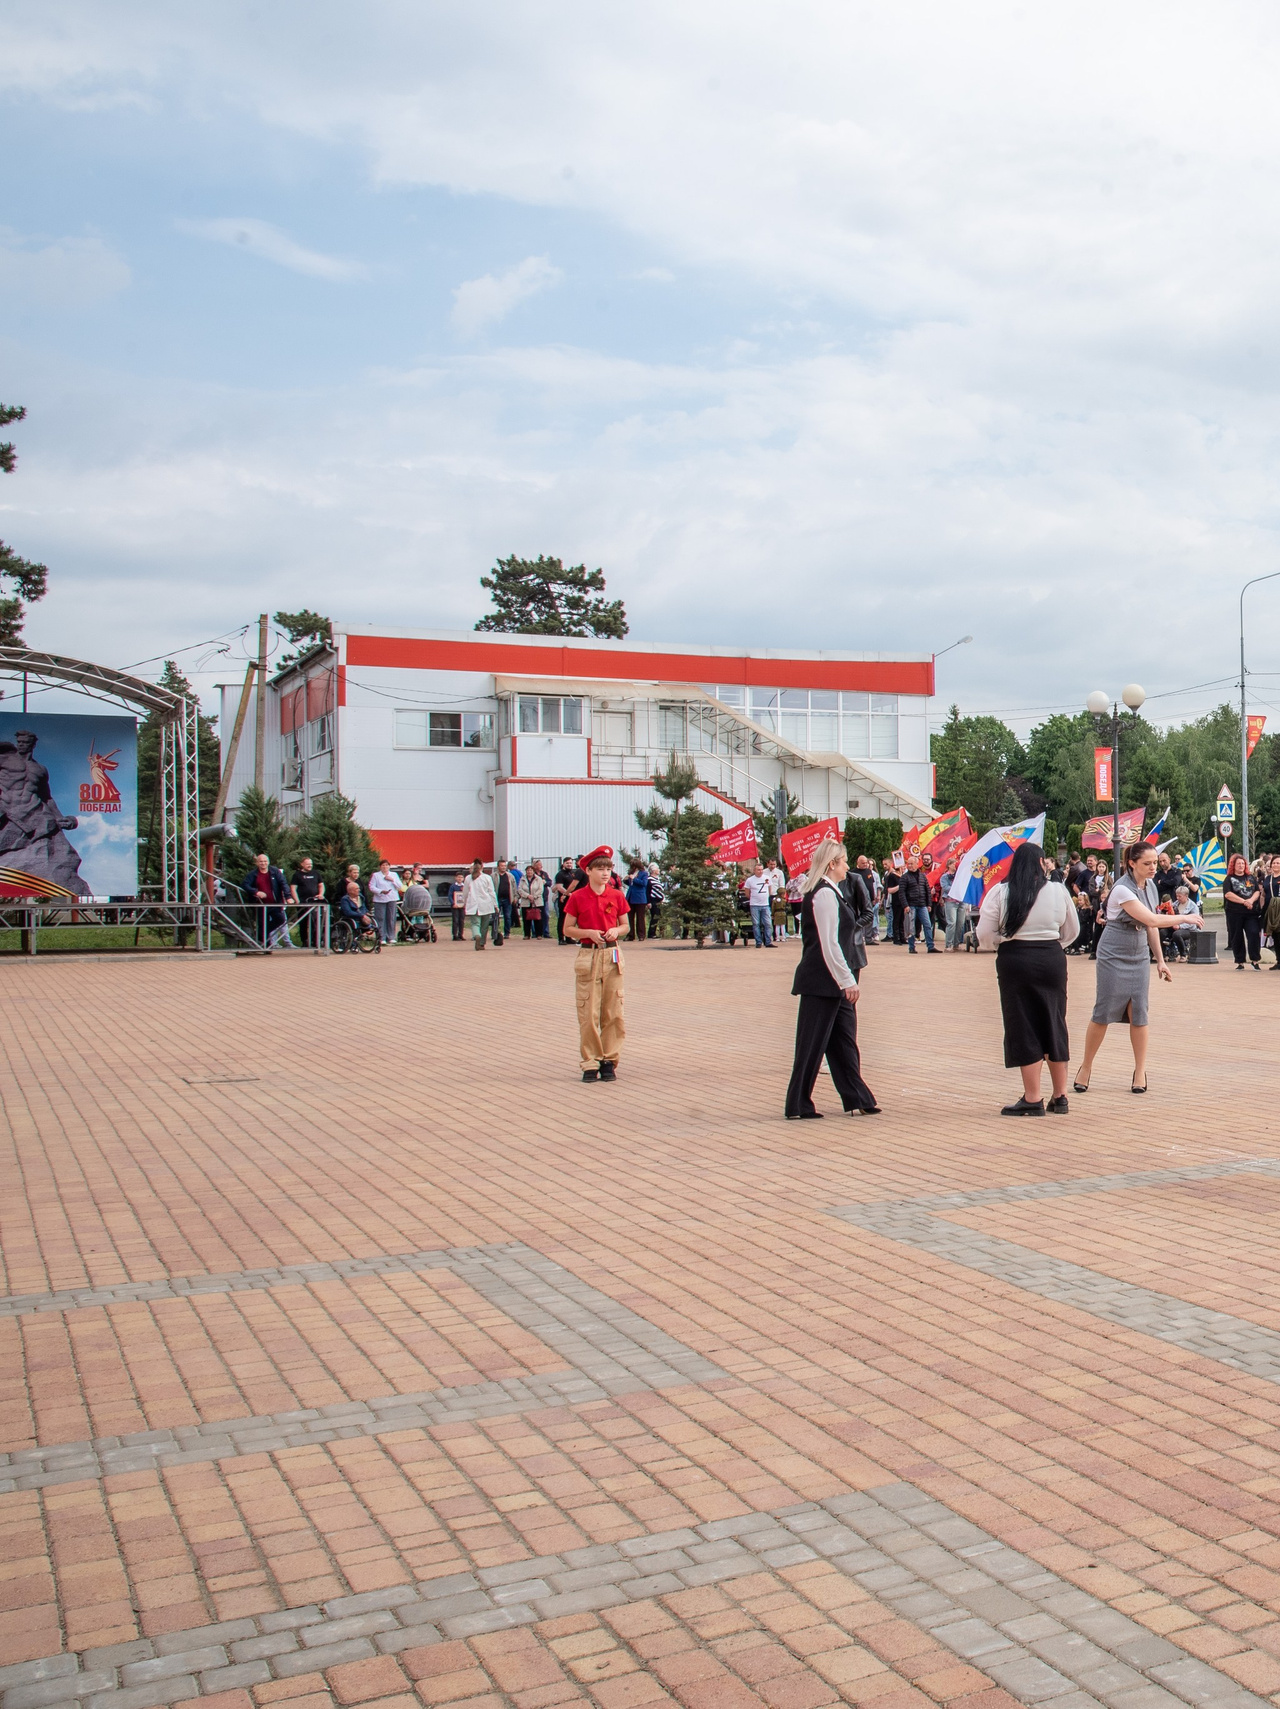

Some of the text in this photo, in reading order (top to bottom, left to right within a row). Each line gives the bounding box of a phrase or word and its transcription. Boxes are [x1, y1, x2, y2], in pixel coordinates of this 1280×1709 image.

[1099, 764, 1108, 796] ПОБЕДА!
[79, 783, 102, 801] 80
[79, 803, 122, 813] ПОБЕДА!
[1222, 825, 1231, 833] 40
[756, 882, 767, 894] Z
